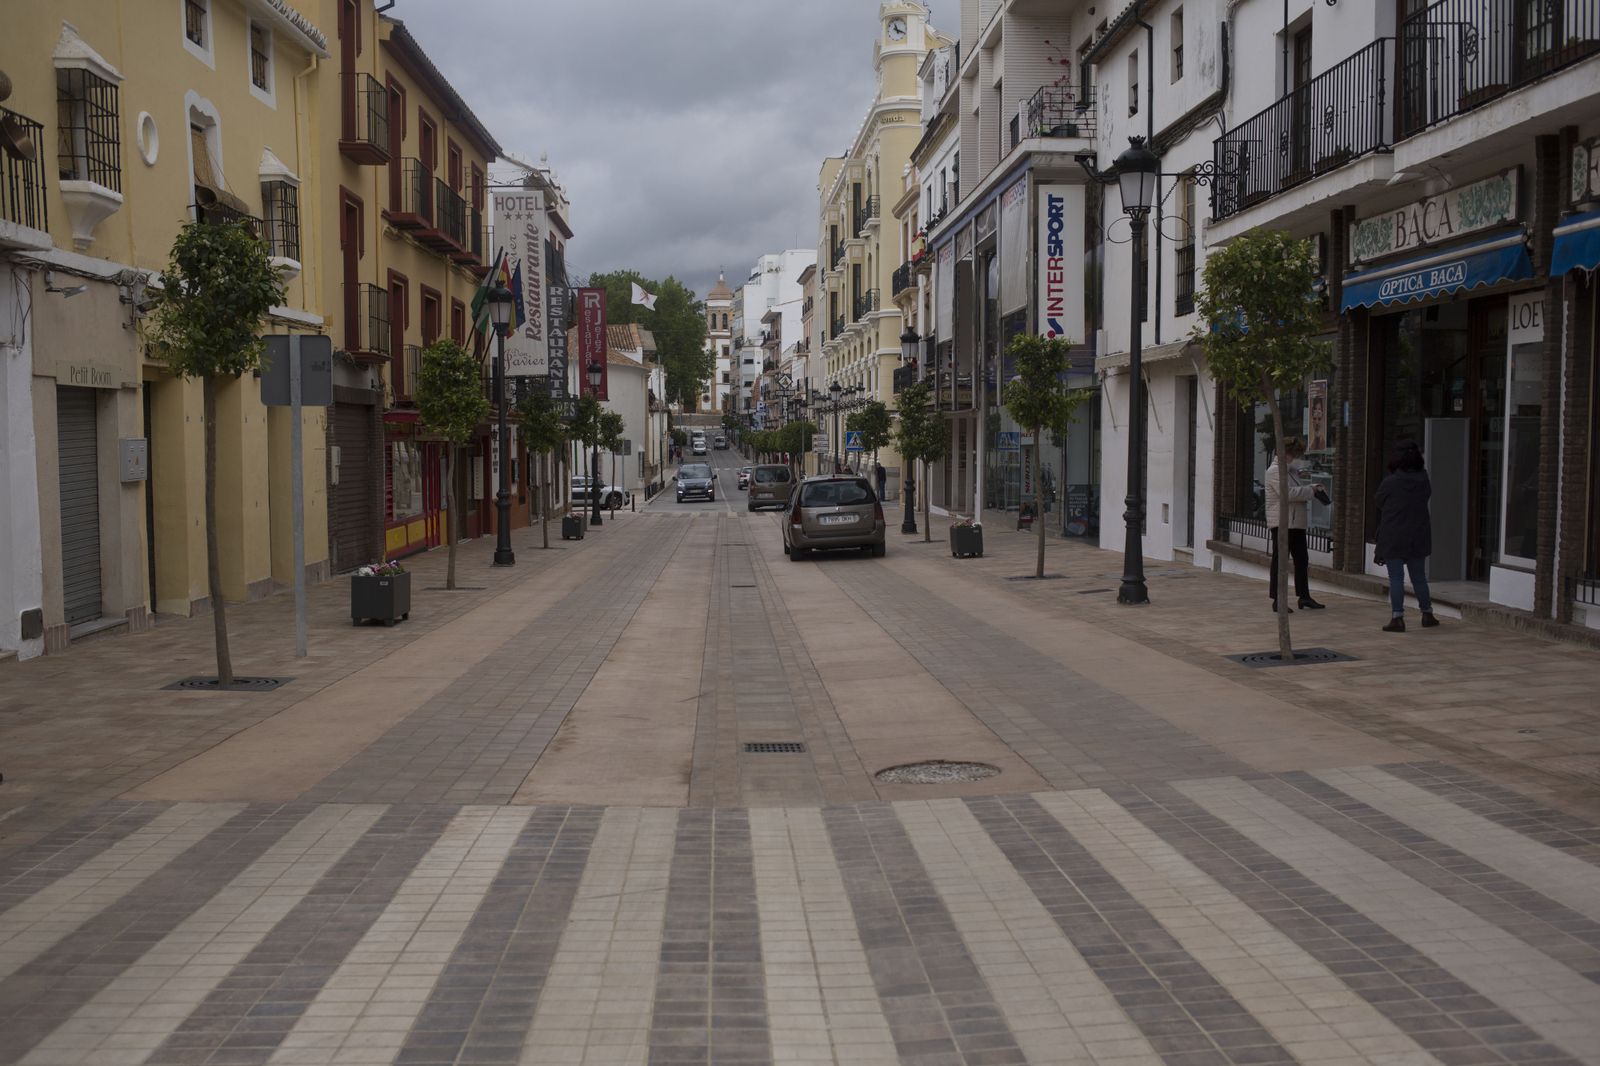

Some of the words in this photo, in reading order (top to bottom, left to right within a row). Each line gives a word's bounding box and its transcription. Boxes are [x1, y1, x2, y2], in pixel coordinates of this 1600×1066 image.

[495, 196, 543, 212] HOTEL
[1394, 197, 1454, 248] BACA
[1047, 194, 1064, 317] INTERSPORT
[523, 223, 542, 342] Restaurante
[1381, 273, 1423, 296] OPTICA
[1430, 266, 1464, 285] BACA
[549, 287, 565, 399] RESTAURANTE
[594, 310, 602, 352] Jerez
[70, 366, 88, 384] Petit
